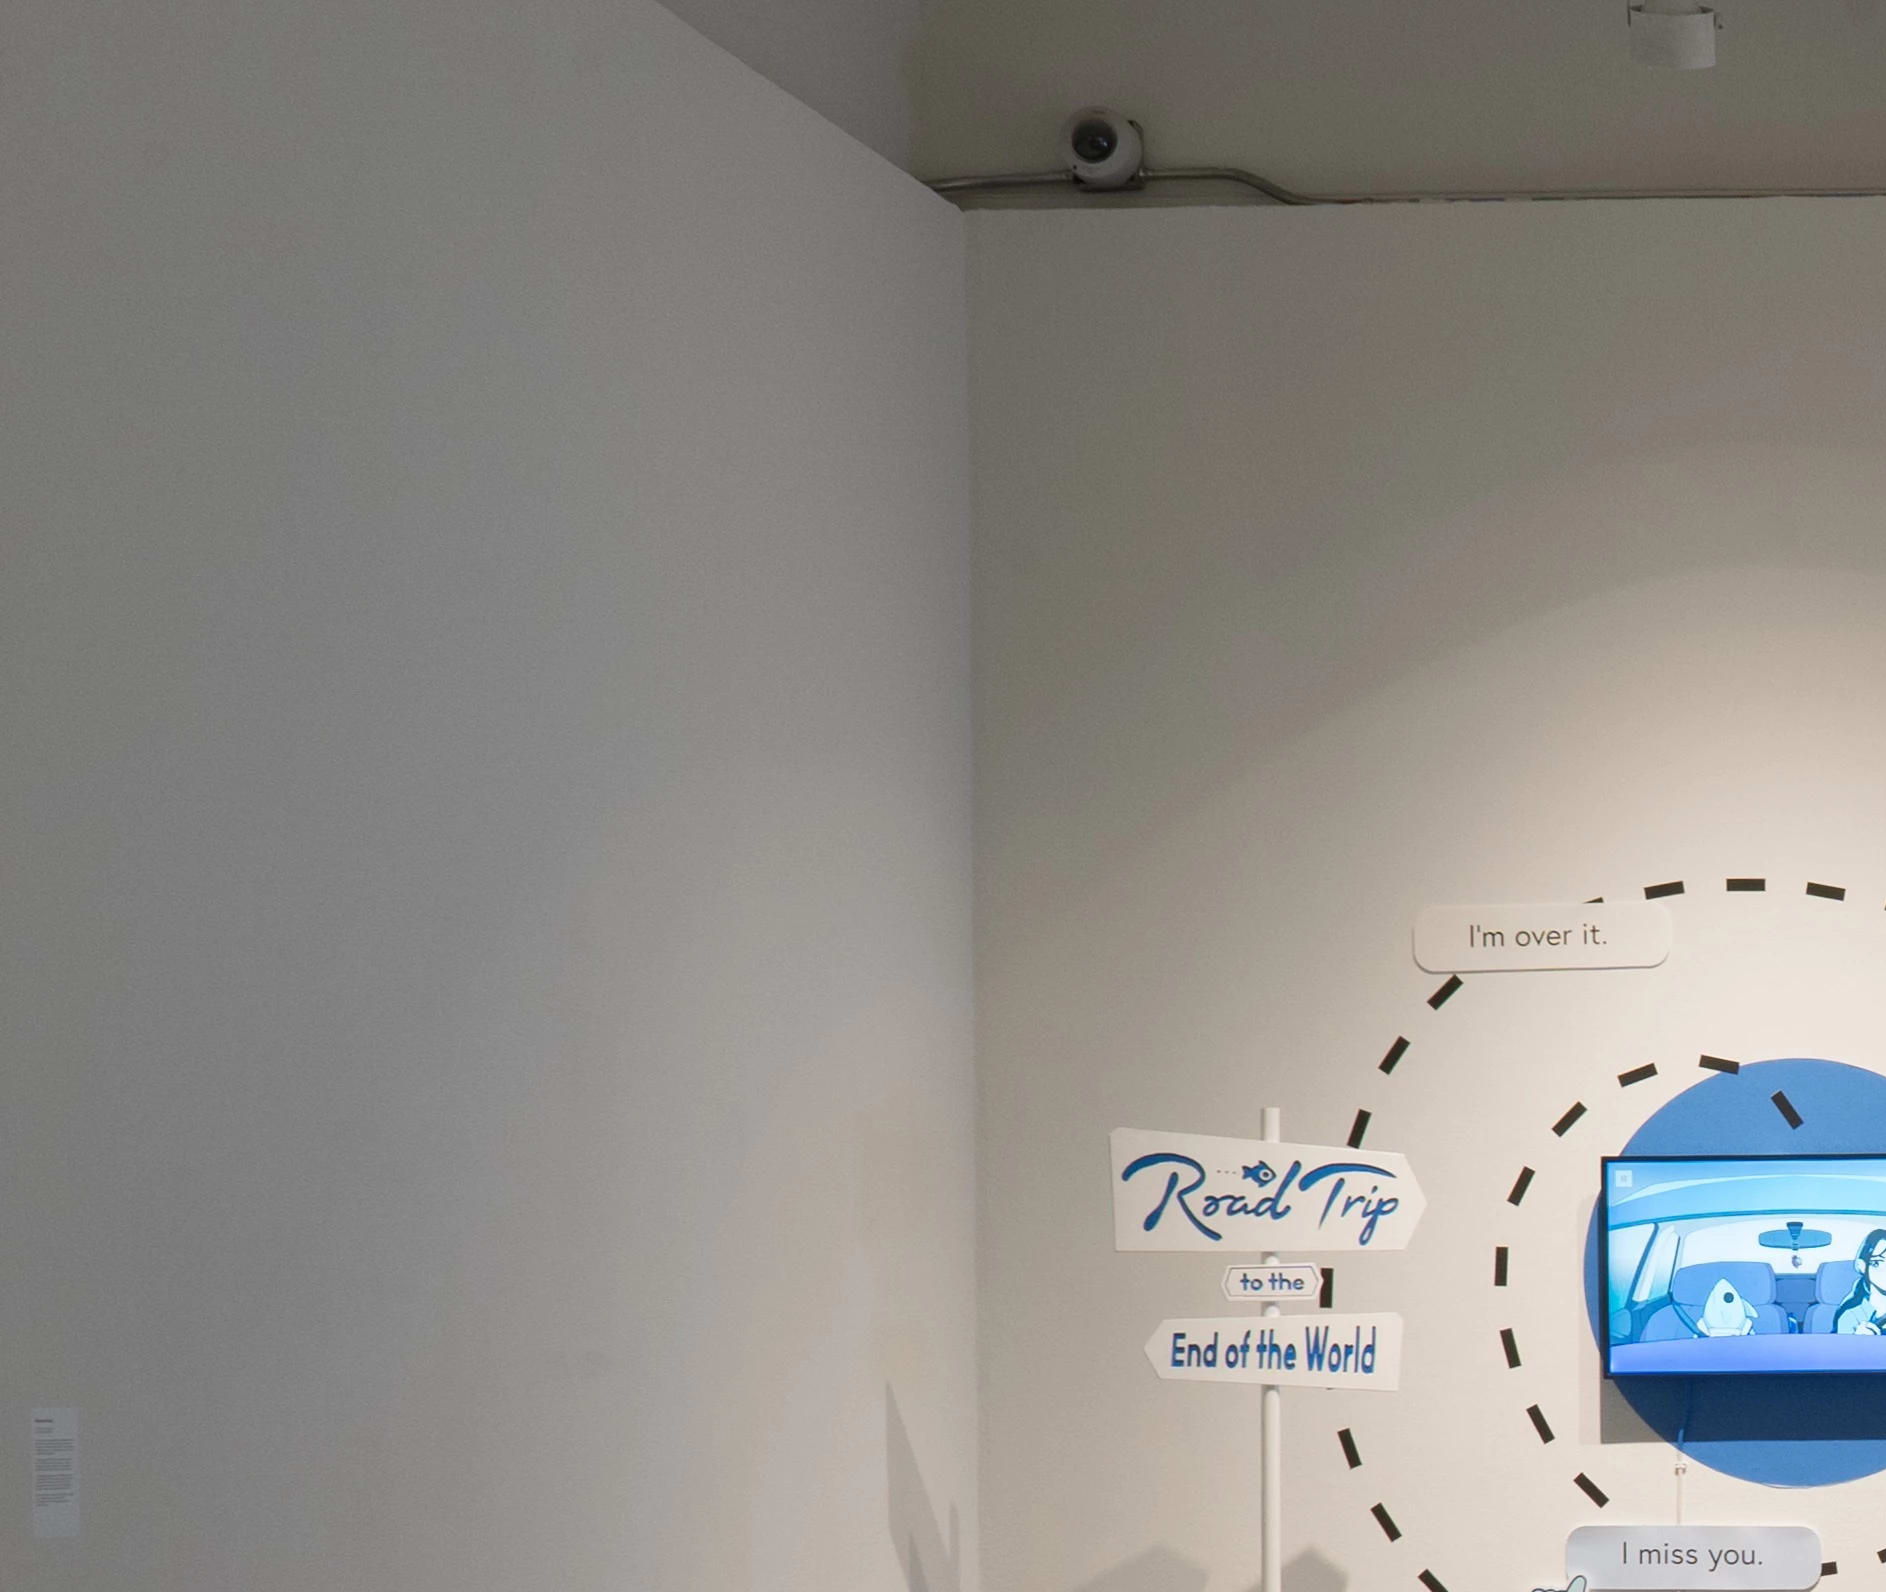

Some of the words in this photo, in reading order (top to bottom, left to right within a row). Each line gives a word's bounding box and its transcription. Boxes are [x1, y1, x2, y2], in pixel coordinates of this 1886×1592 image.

[1470, 924, 1504, 948] I'm
[1515, 929, 1573, 947] over
[1583, 922, 1607, 945] it.
[1121, 1152, 1302, 1242] Road
[1299, 1162, 1399, 1246] Trip
[1239, 1272, 1264, 1292] to
[1267, 1272, 1305, 1291] the
[1170, 1331, 1219, 1368] End
[1224, 1329, 1252, 1370] of
[1256, 1328, 1297, 1371] the
[1305, 1325, 1377, 1375] World
[1622, 1541, 1628, 1565] I
[1638, 1542, 1698, 1565] miss
[1708, 1548, 1763, 1572] you.
